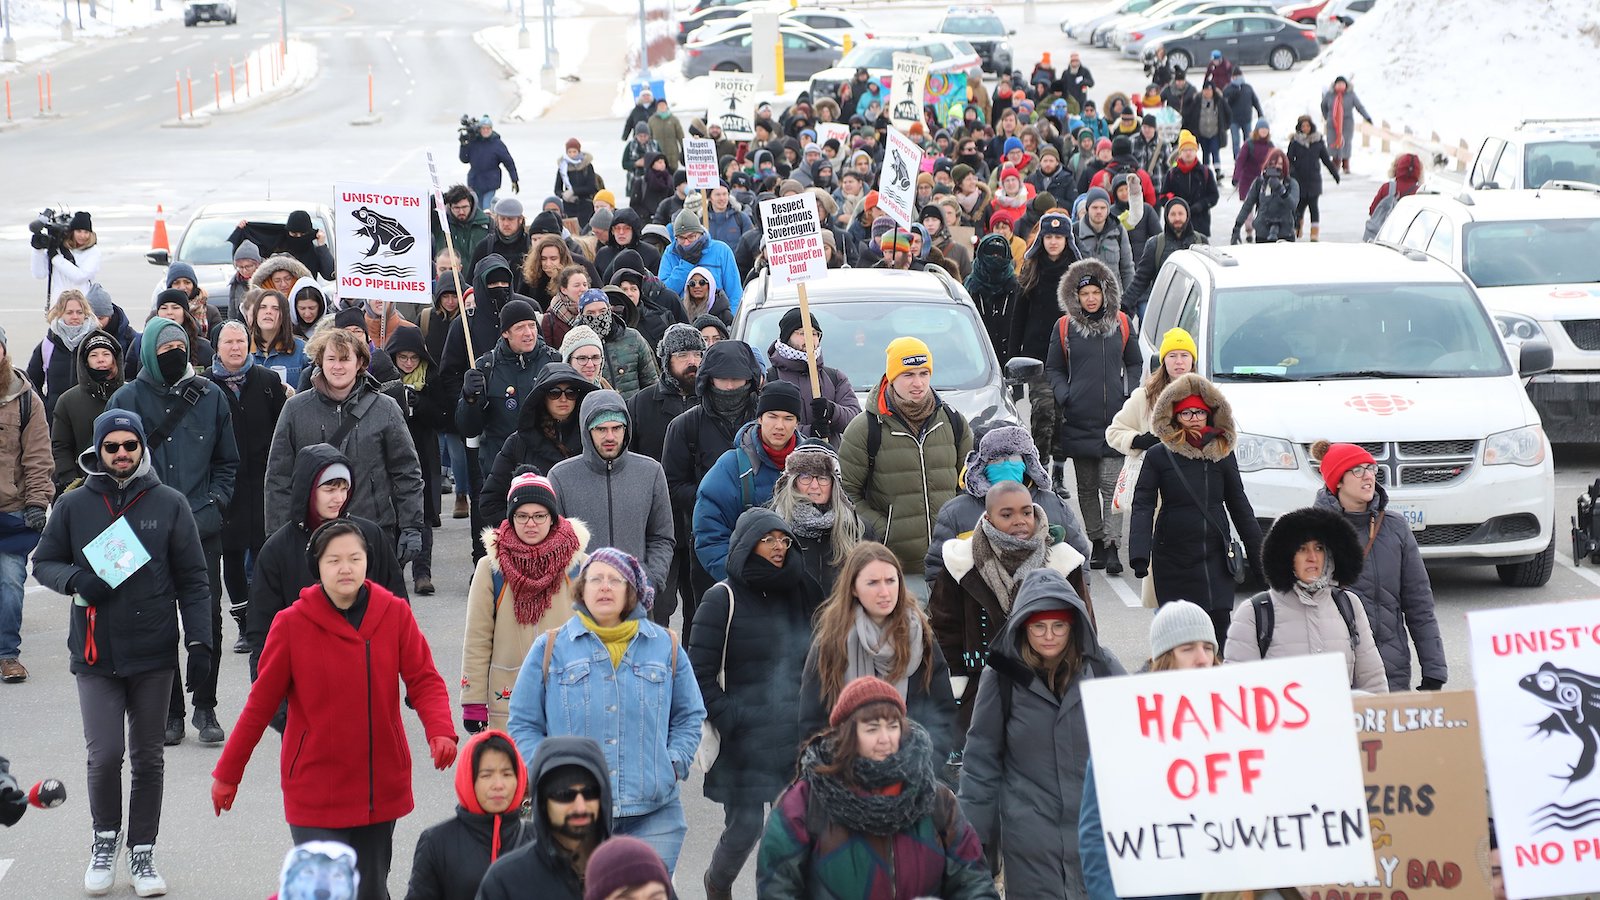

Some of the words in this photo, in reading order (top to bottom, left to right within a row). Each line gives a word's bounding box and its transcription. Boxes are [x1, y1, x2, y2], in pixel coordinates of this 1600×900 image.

[897, 63, 924, 75] PROTECT
[715, 81, 754, 91] PROTECT
[687, 154, 714, 162] Sovereignty
[342, 192, 420, 207] UNIST'OT'EN
[771, 198, 805, 215] Respect
[767, 210, 813, 227] Indigenous
[887, 201, 910, 222] PIPELINES
[767, 221, 816, 240] Sovereignty
[772, 243, 783, 254] No
[783, 238, 806, 252] RCMP
[807, 237, 817, 247] on
[770, 248, 823, 266] Wet'suwet'en
[789, 261, 807, 274] land
[342, 277, 362, 287] NO
[365, 278, 426, 291] PIPELINES
[1136, 682, 1310, 743] HANDS
[1392, 707, 1468, 733] LIKE...
[1166, 749, 1265, 800] OFF
[1106, 804, 1365, 860] WET'SUWET'EN
[1514, 841, 1565, 868] NO
[1406, 858, 1463, 890] BAD
